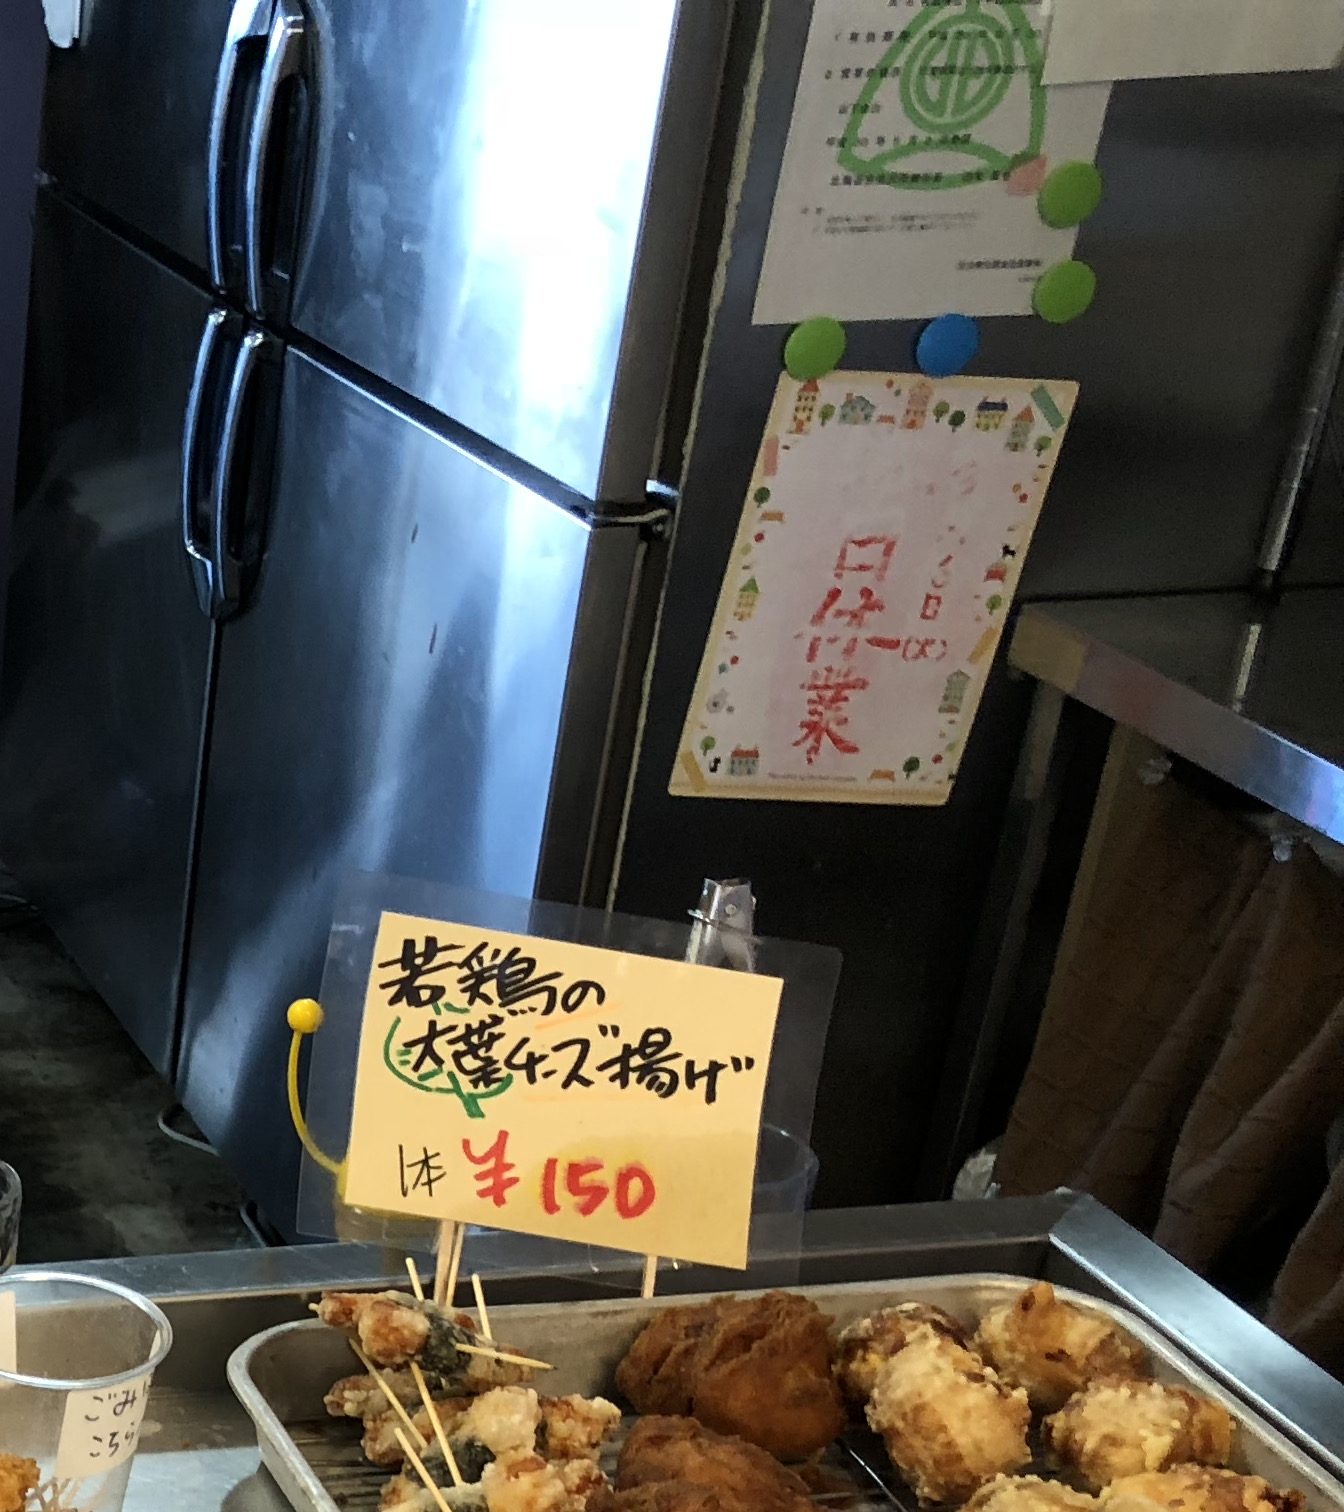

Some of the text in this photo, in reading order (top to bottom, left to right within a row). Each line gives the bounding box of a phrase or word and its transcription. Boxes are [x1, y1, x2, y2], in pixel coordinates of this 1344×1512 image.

[378, 935, 606, 1016] 若鶏の
[401, 1013, 755, 1106] 大葉チーズ揚げ
[462, 1129, 656, 1220] ¥150
